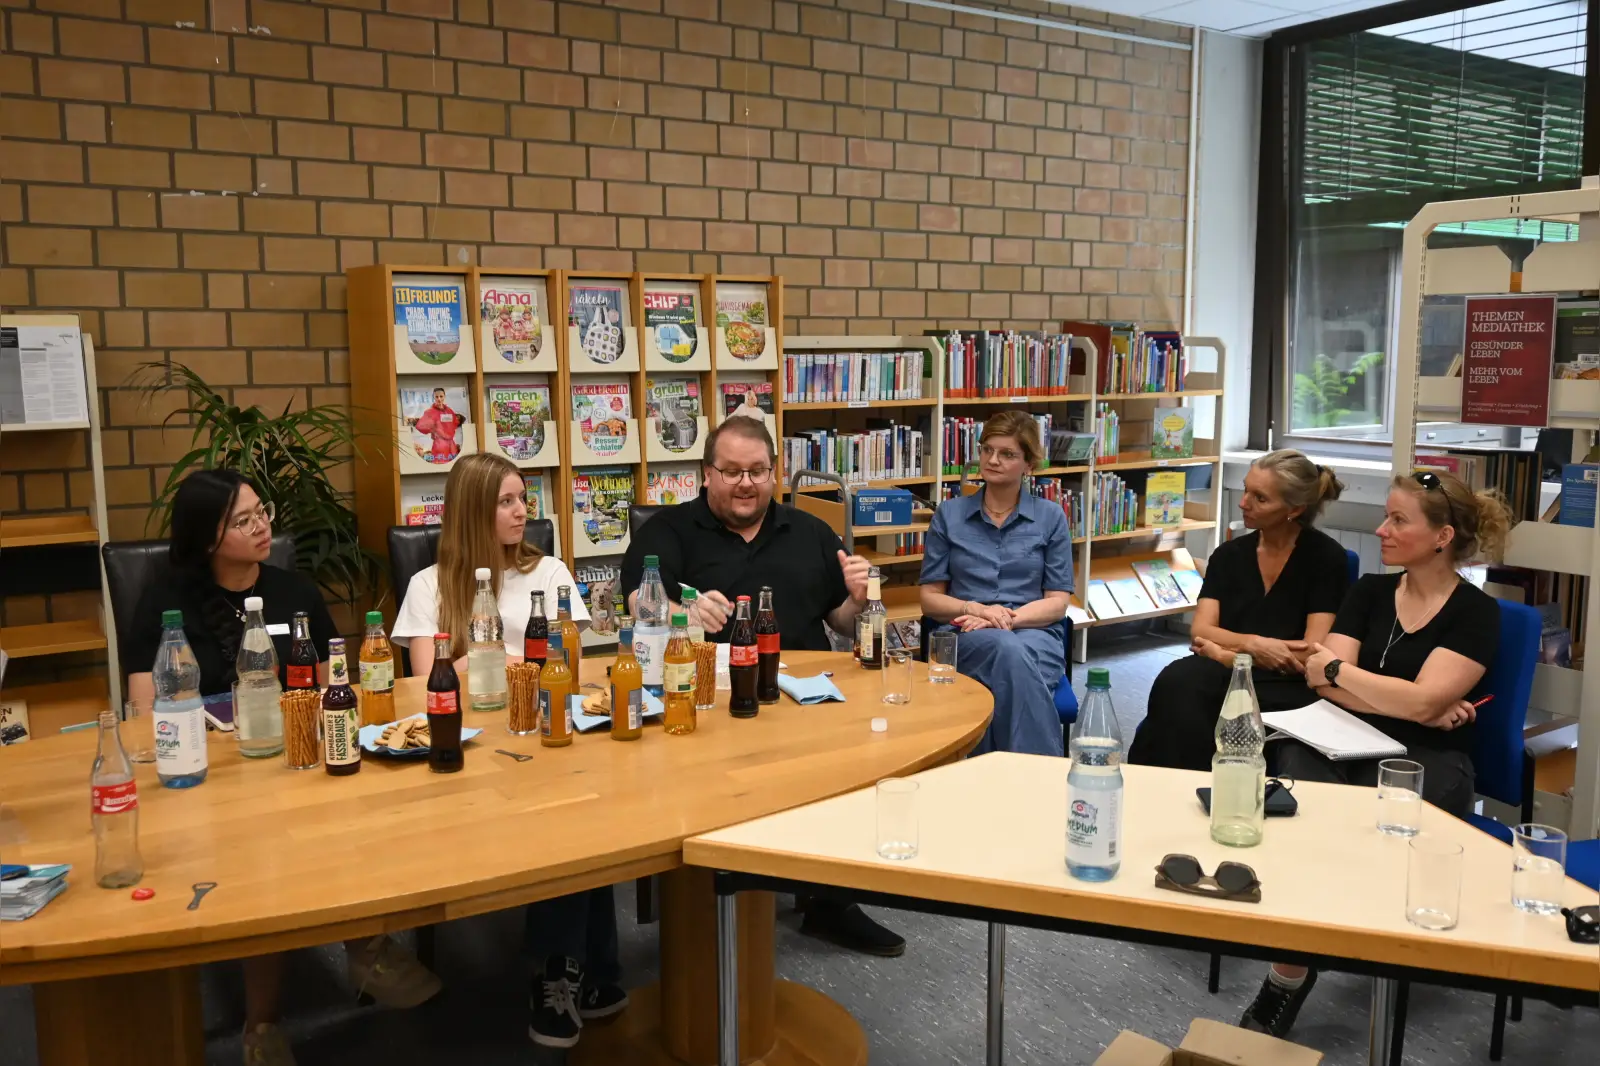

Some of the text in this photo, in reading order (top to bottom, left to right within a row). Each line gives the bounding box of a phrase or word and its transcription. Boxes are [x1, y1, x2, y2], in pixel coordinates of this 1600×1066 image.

[484, 289, 531, 305] Anna
[644, 295, 679, 309] CHIP
[1472, 311, 1524, 321] THEMEN
[1471, 322, 1545, 332] MEDIATHEK
[1470, 341, 1523, 350] GESÜNDER
[1470, 350, 1501, 358] LEBEN
[1469, 367, 1523, 376] MEHR VOM
[1469, 375, 1499, 384] LEBEN
[653, 383, 684, 396] grün
[496, 391, 537, 404] garten
[594, 437, 619, 445] Besser
[574, 479, 589, 488] Lisa
[589, 476, 631, 491] Wohnen
[576, 567, 614, 583] Hund
[334, 714, 347, 760] FASSBRAUSE
[1067, 817, 1098, 834] MEDIUM
